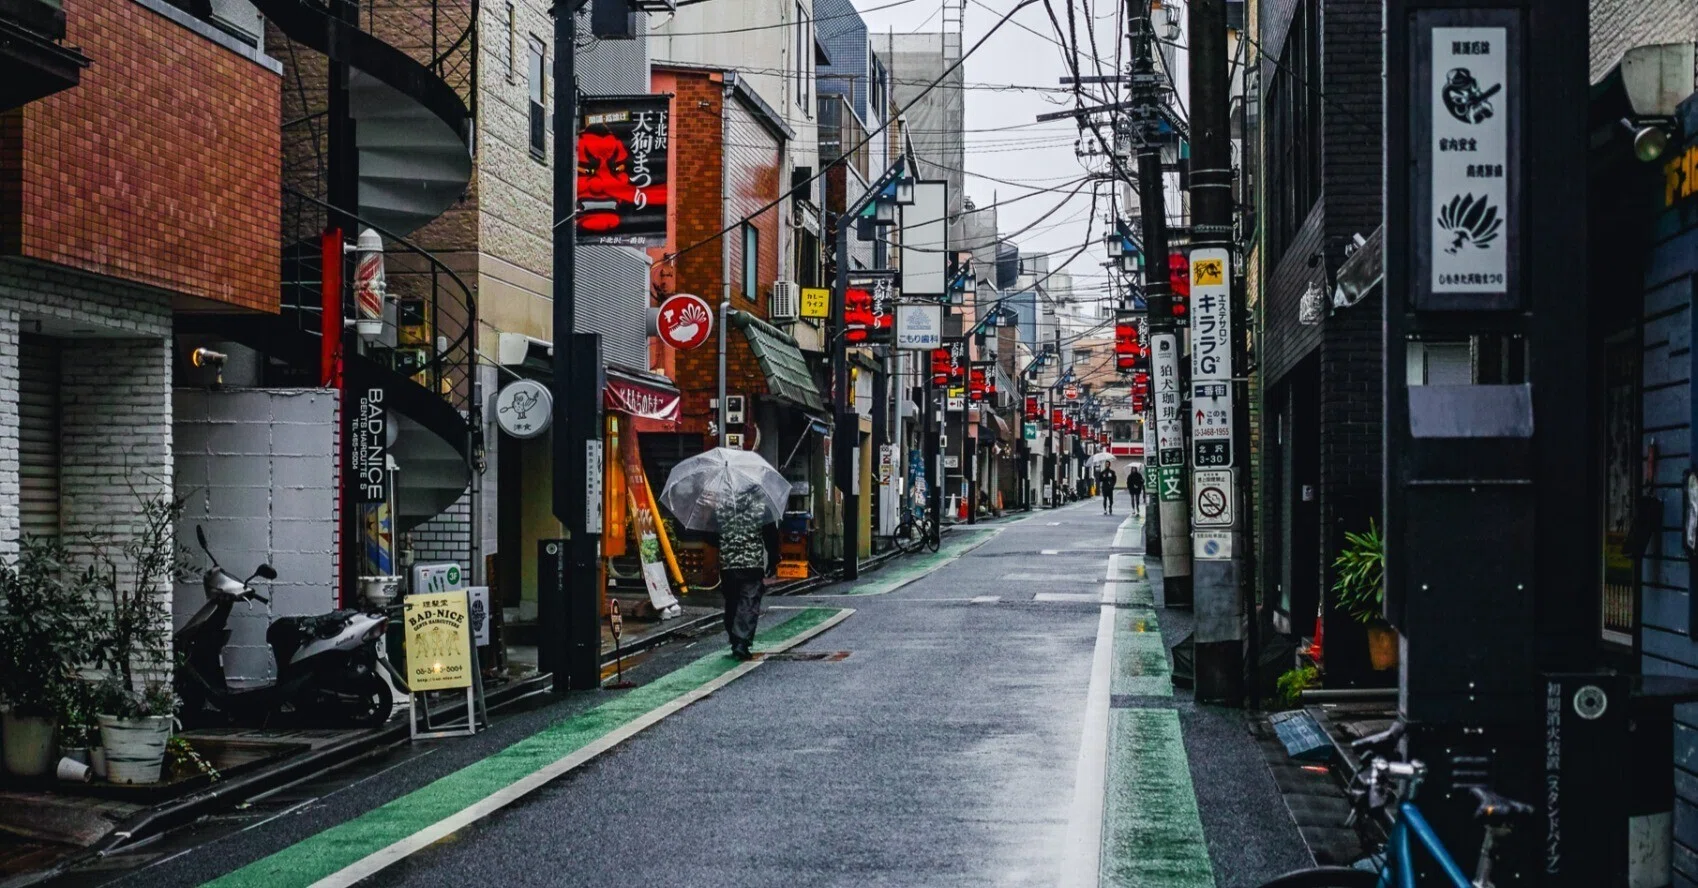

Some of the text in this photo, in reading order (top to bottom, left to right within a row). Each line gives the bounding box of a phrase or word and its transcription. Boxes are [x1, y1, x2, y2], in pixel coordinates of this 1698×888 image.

[655, 110, 668, 150] 下北沢
[1439, 137, 1477, 152] 家内安全
[630, 110, 654, 211] 天狗まつり
[1438, 273, 1503, 285] しもきた天狗まつり
[872, 278, 885, 330] 天狗まつり
[1218, 294, 1228, 346] エステサロン
[898, 333, 939, 344] こもり歯科
[1160, 364, 1175, 418] 狛犬珈琲
[1195, 385, 1226, 396] 一番街
[368, 388, 383, 500] BAD-NICE
[1200, 455, 1224, 464] 3-30
[1164, 476, 1181, 496] 文
[449, 571, 458, 581] 3F
[409, 609, 465, 627] BAD-NICE
[413, 618, 460, 632] GENTS HAIRCUTTERS
